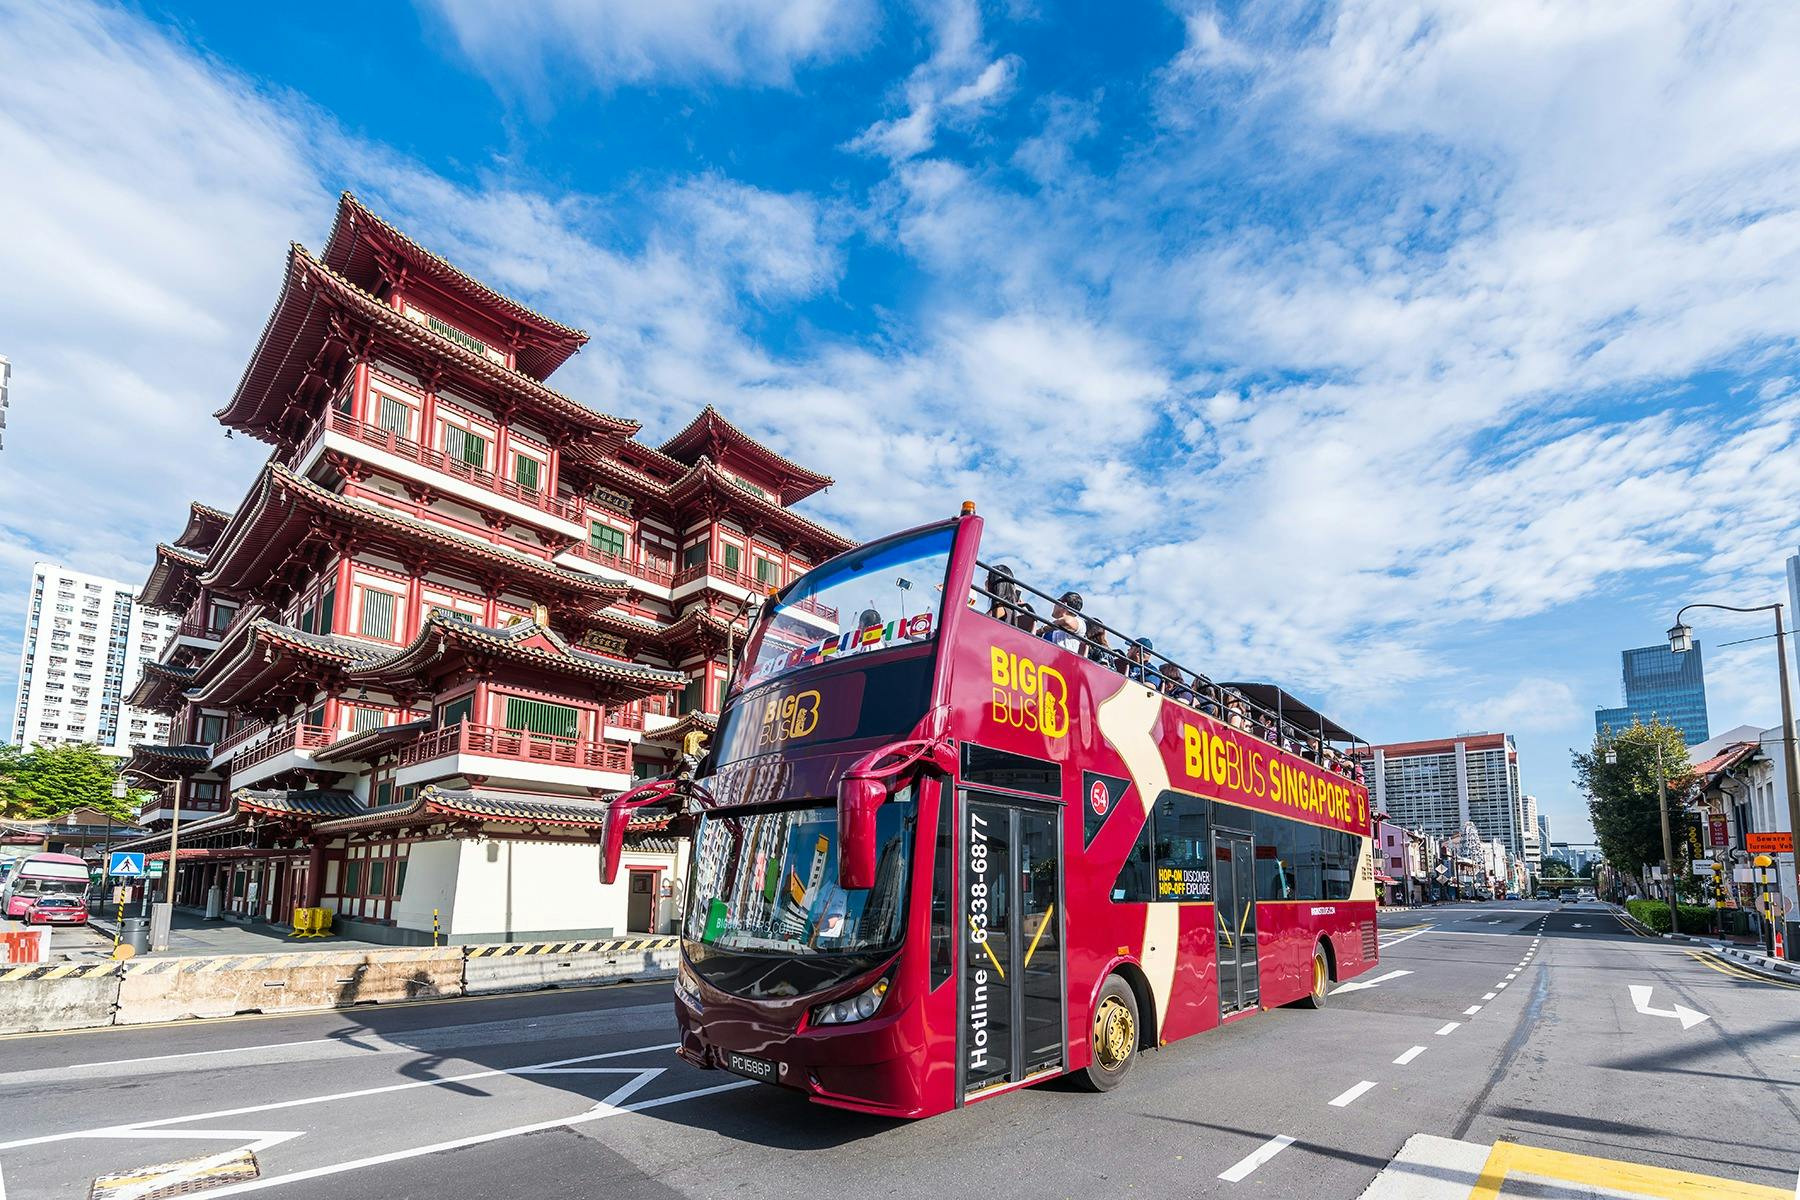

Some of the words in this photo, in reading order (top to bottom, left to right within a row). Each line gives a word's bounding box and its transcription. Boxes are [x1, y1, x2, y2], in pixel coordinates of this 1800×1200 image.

[991, 645, 1037, 695] BIG
[764, 695, 796, 724] BIG
[992, 686, 1038, 732] BUS
[759, 719, 791, 746] BUS
[1093, 788, 1107, 808] 54
[1269, 758, 1352, 823] SINGAPORE
[970, 812, 989, 944] 6338-6877
[1158, 868, 1183, 881] HOP-ON
[1183, 870, 1211, 883] DISCOVER
[1158, 881, 1186, 895] HOP-OFF
[1186, 882, 1211, 895] EXPLORE
[716, 918, 794, 935] BIGBUSTOURS.COM
[970, 968, 988, 1070] Hotline
[732, 1056, 771, 1076] PC1586P
